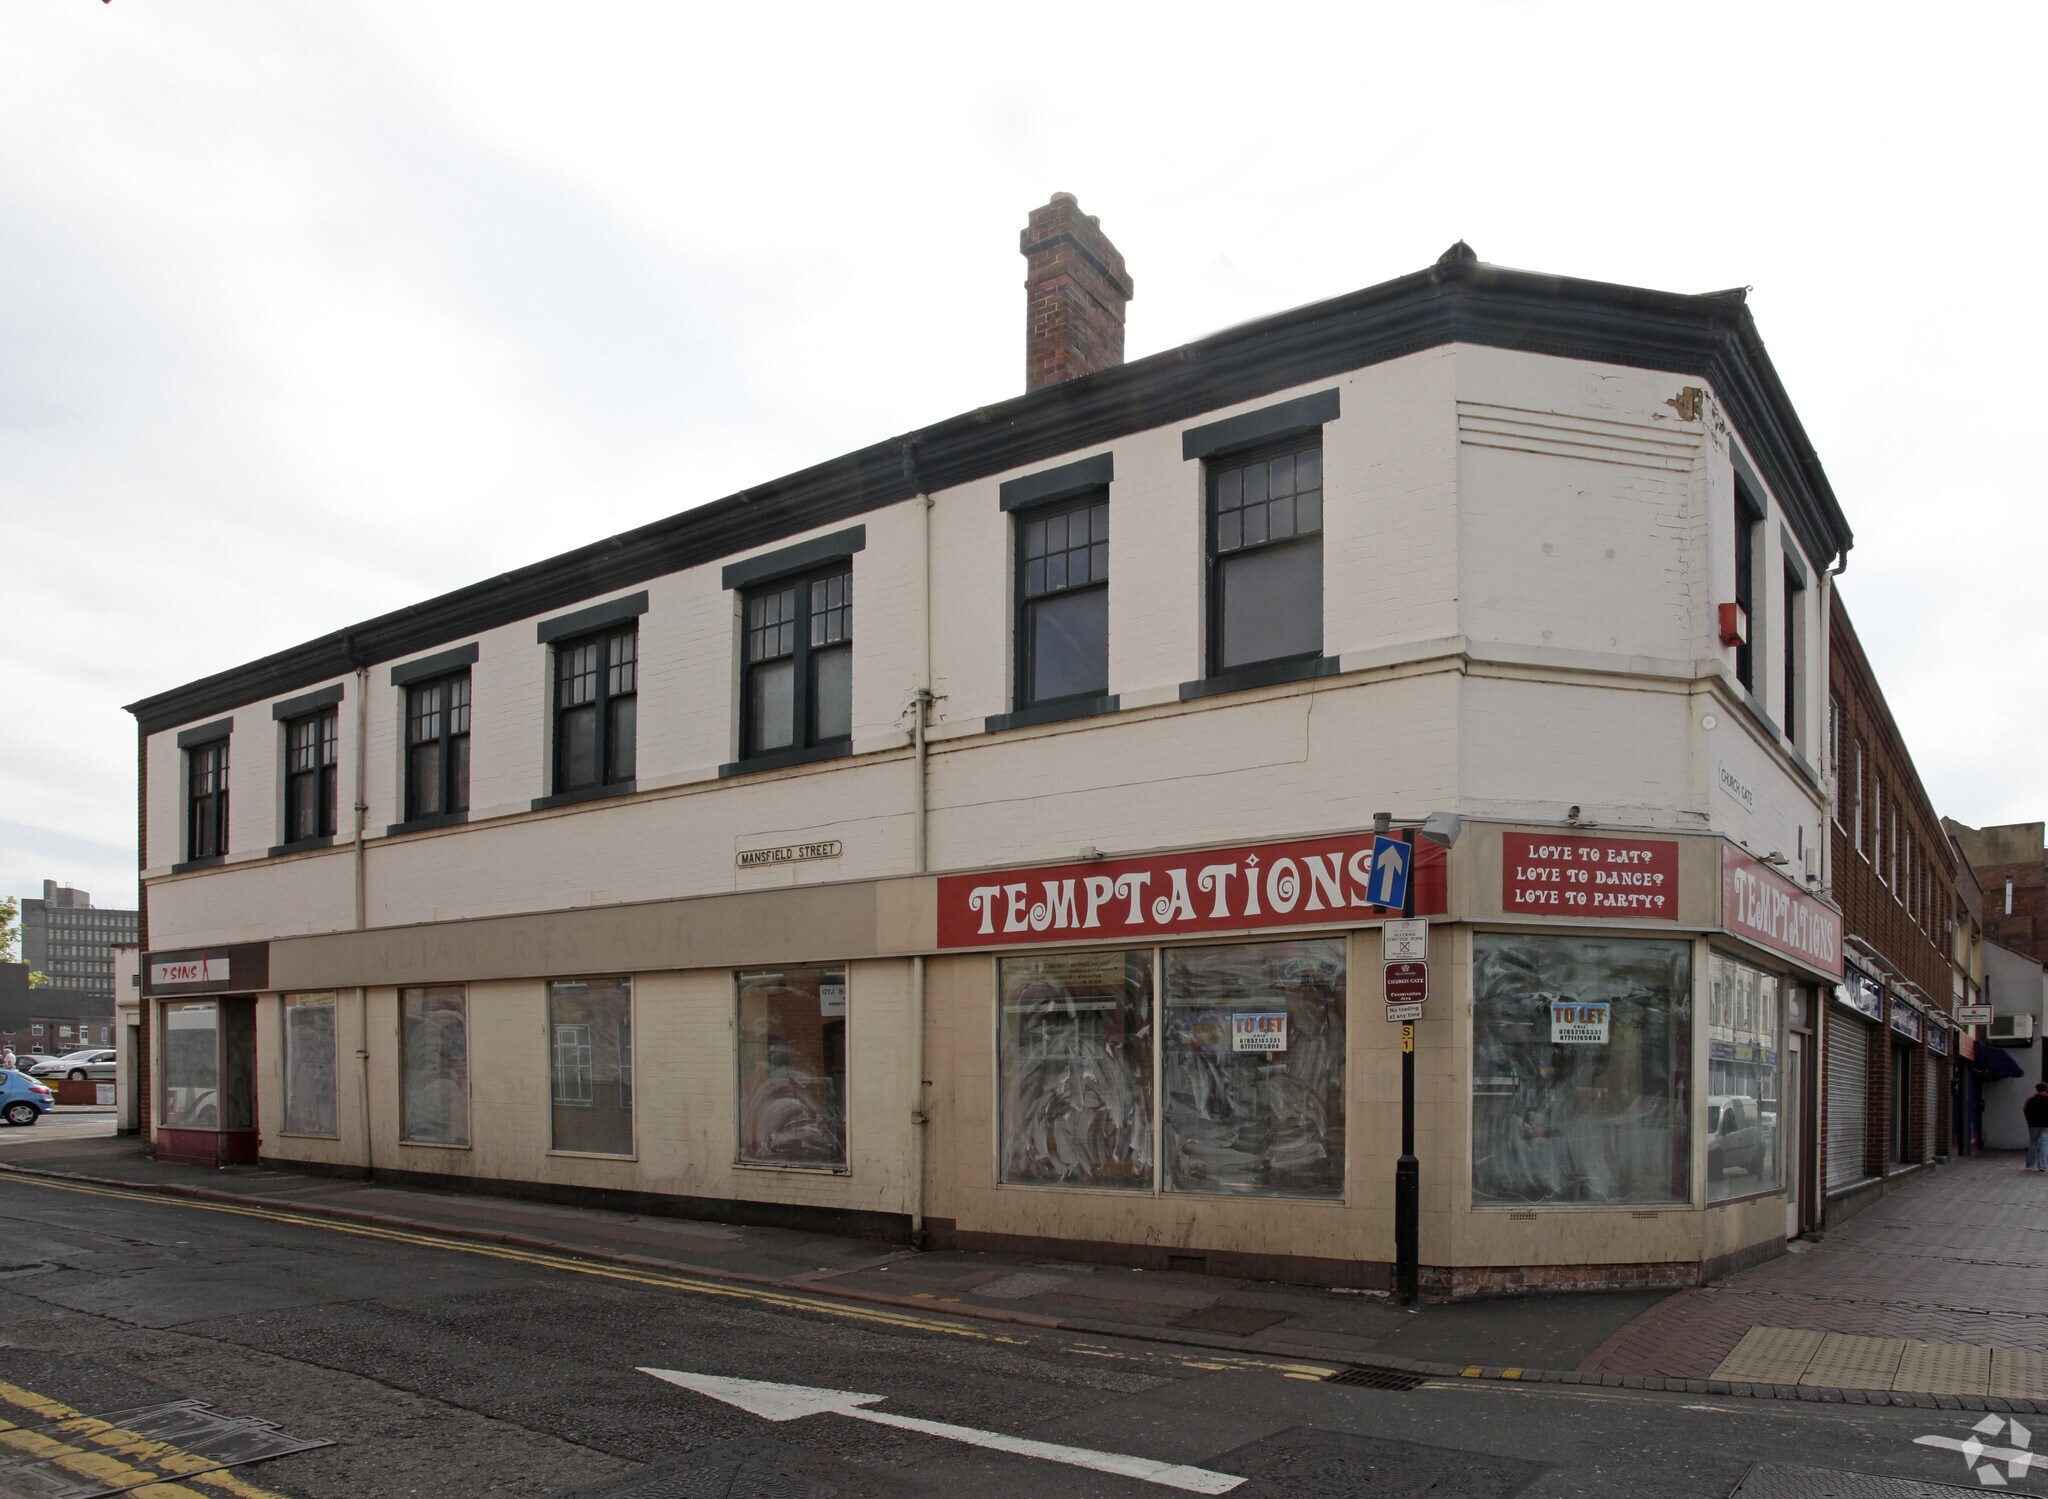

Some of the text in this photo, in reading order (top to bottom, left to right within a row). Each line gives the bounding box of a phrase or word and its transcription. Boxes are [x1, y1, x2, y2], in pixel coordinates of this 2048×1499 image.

[1721, 768, 1753, 806] CHURCH GATE
[741, 843, 835, 864] MANSFIELD STREET
[1528, 845, 1653, 864] LOVE TO EAT?
[1516, 867, 1664, 887] LOVE TO DANCE?
[968, 850, 1373, 935] TEMPTATIONS
[1515, 889, 1665, 909] LOVE TO PARTY?
[1734, 868, 1834, 964] TEMPTATIONS
[162, 965, 198, 980] 7 SINS
[1398, 1005, 1419, 1013] loading
[1553, 1007, 1605, 1024] TO LET
[1235, 1017, 1285, 1033] TO LET
[1402, 1026, 1411, 1036] S
[1403, 1040, 1409, 1049] 1
